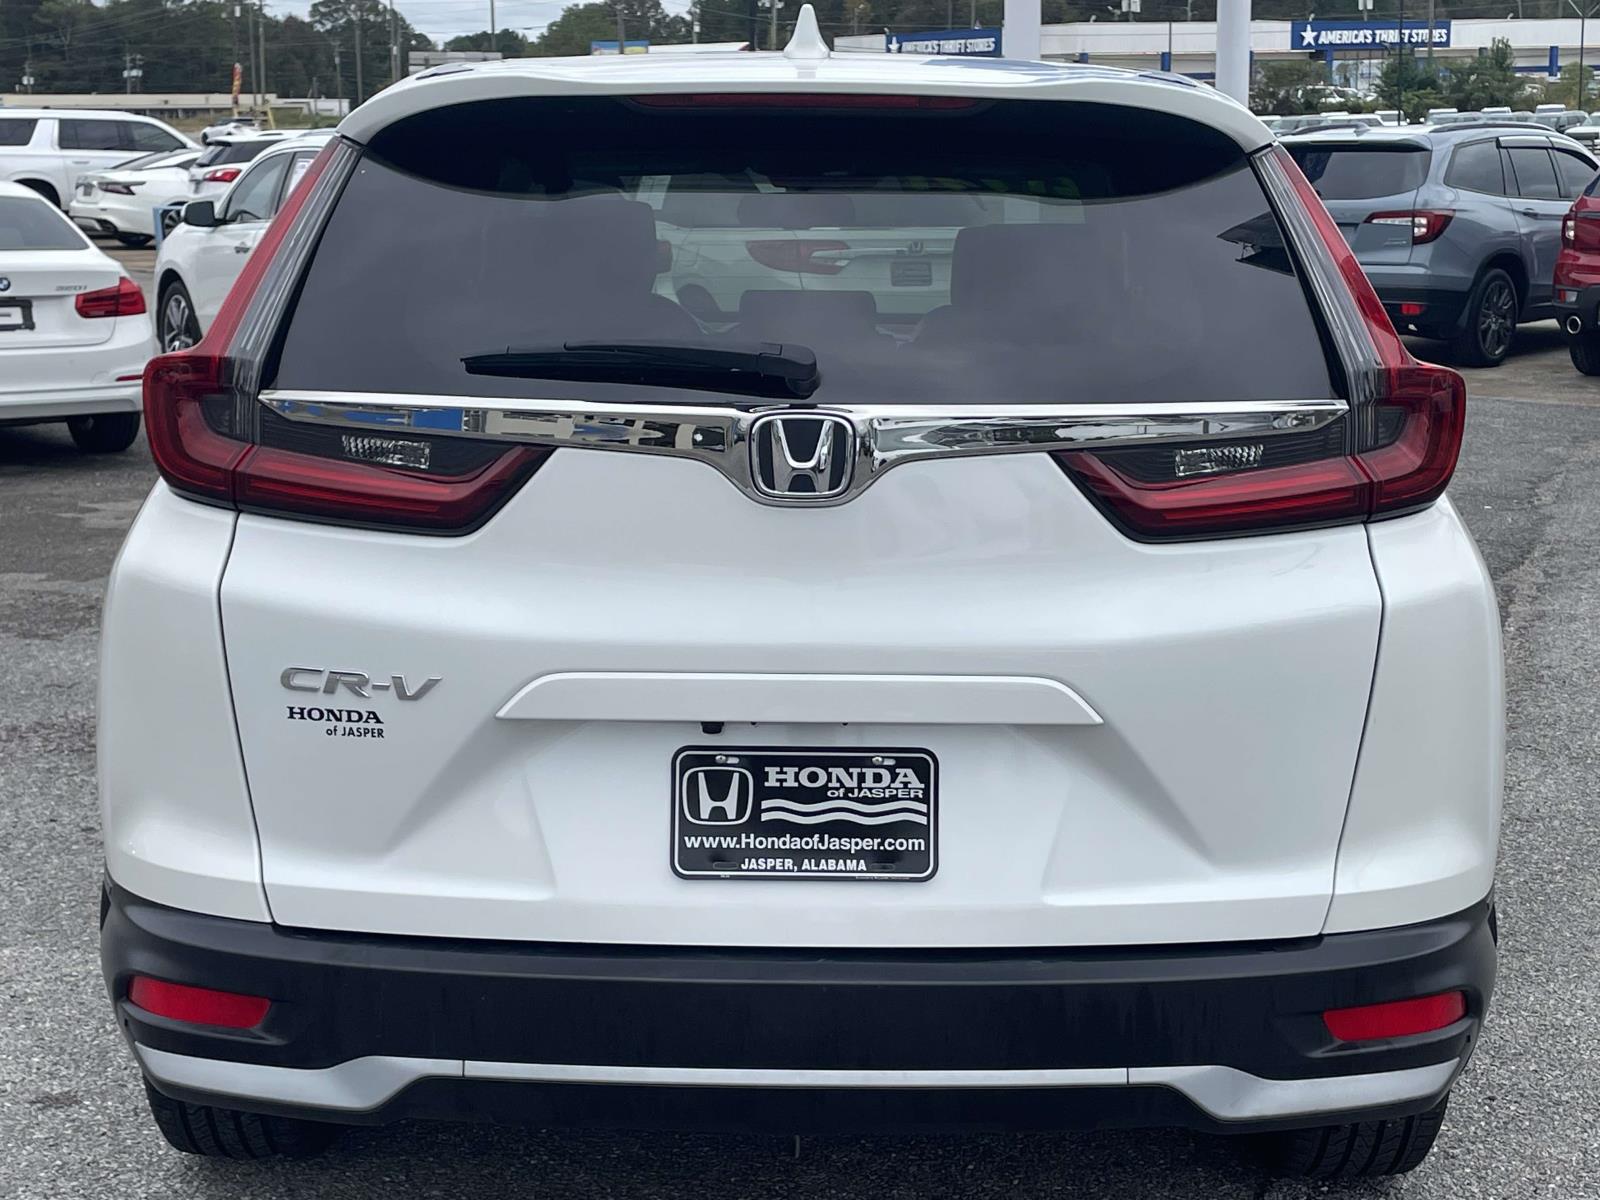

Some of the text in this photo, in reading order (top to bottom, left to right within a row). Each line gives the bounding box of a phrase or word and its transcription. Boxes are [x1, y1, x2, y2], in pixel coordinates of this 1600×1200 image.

[1317, 29, 1373, 44] AMERICA'S
[279, 666, 443, 701] CR-V
[286, 705, 385, 724] HONDA
[325, 725, 385, 739] of JASPER
[763, 766, 926, 789] HONDA
[826, 788, 924, 799] of JASPER
[684, 833, 926, 854] www.HondaofJasper.com
[740, 858, 867, 872] JASPER, ALABAMA
